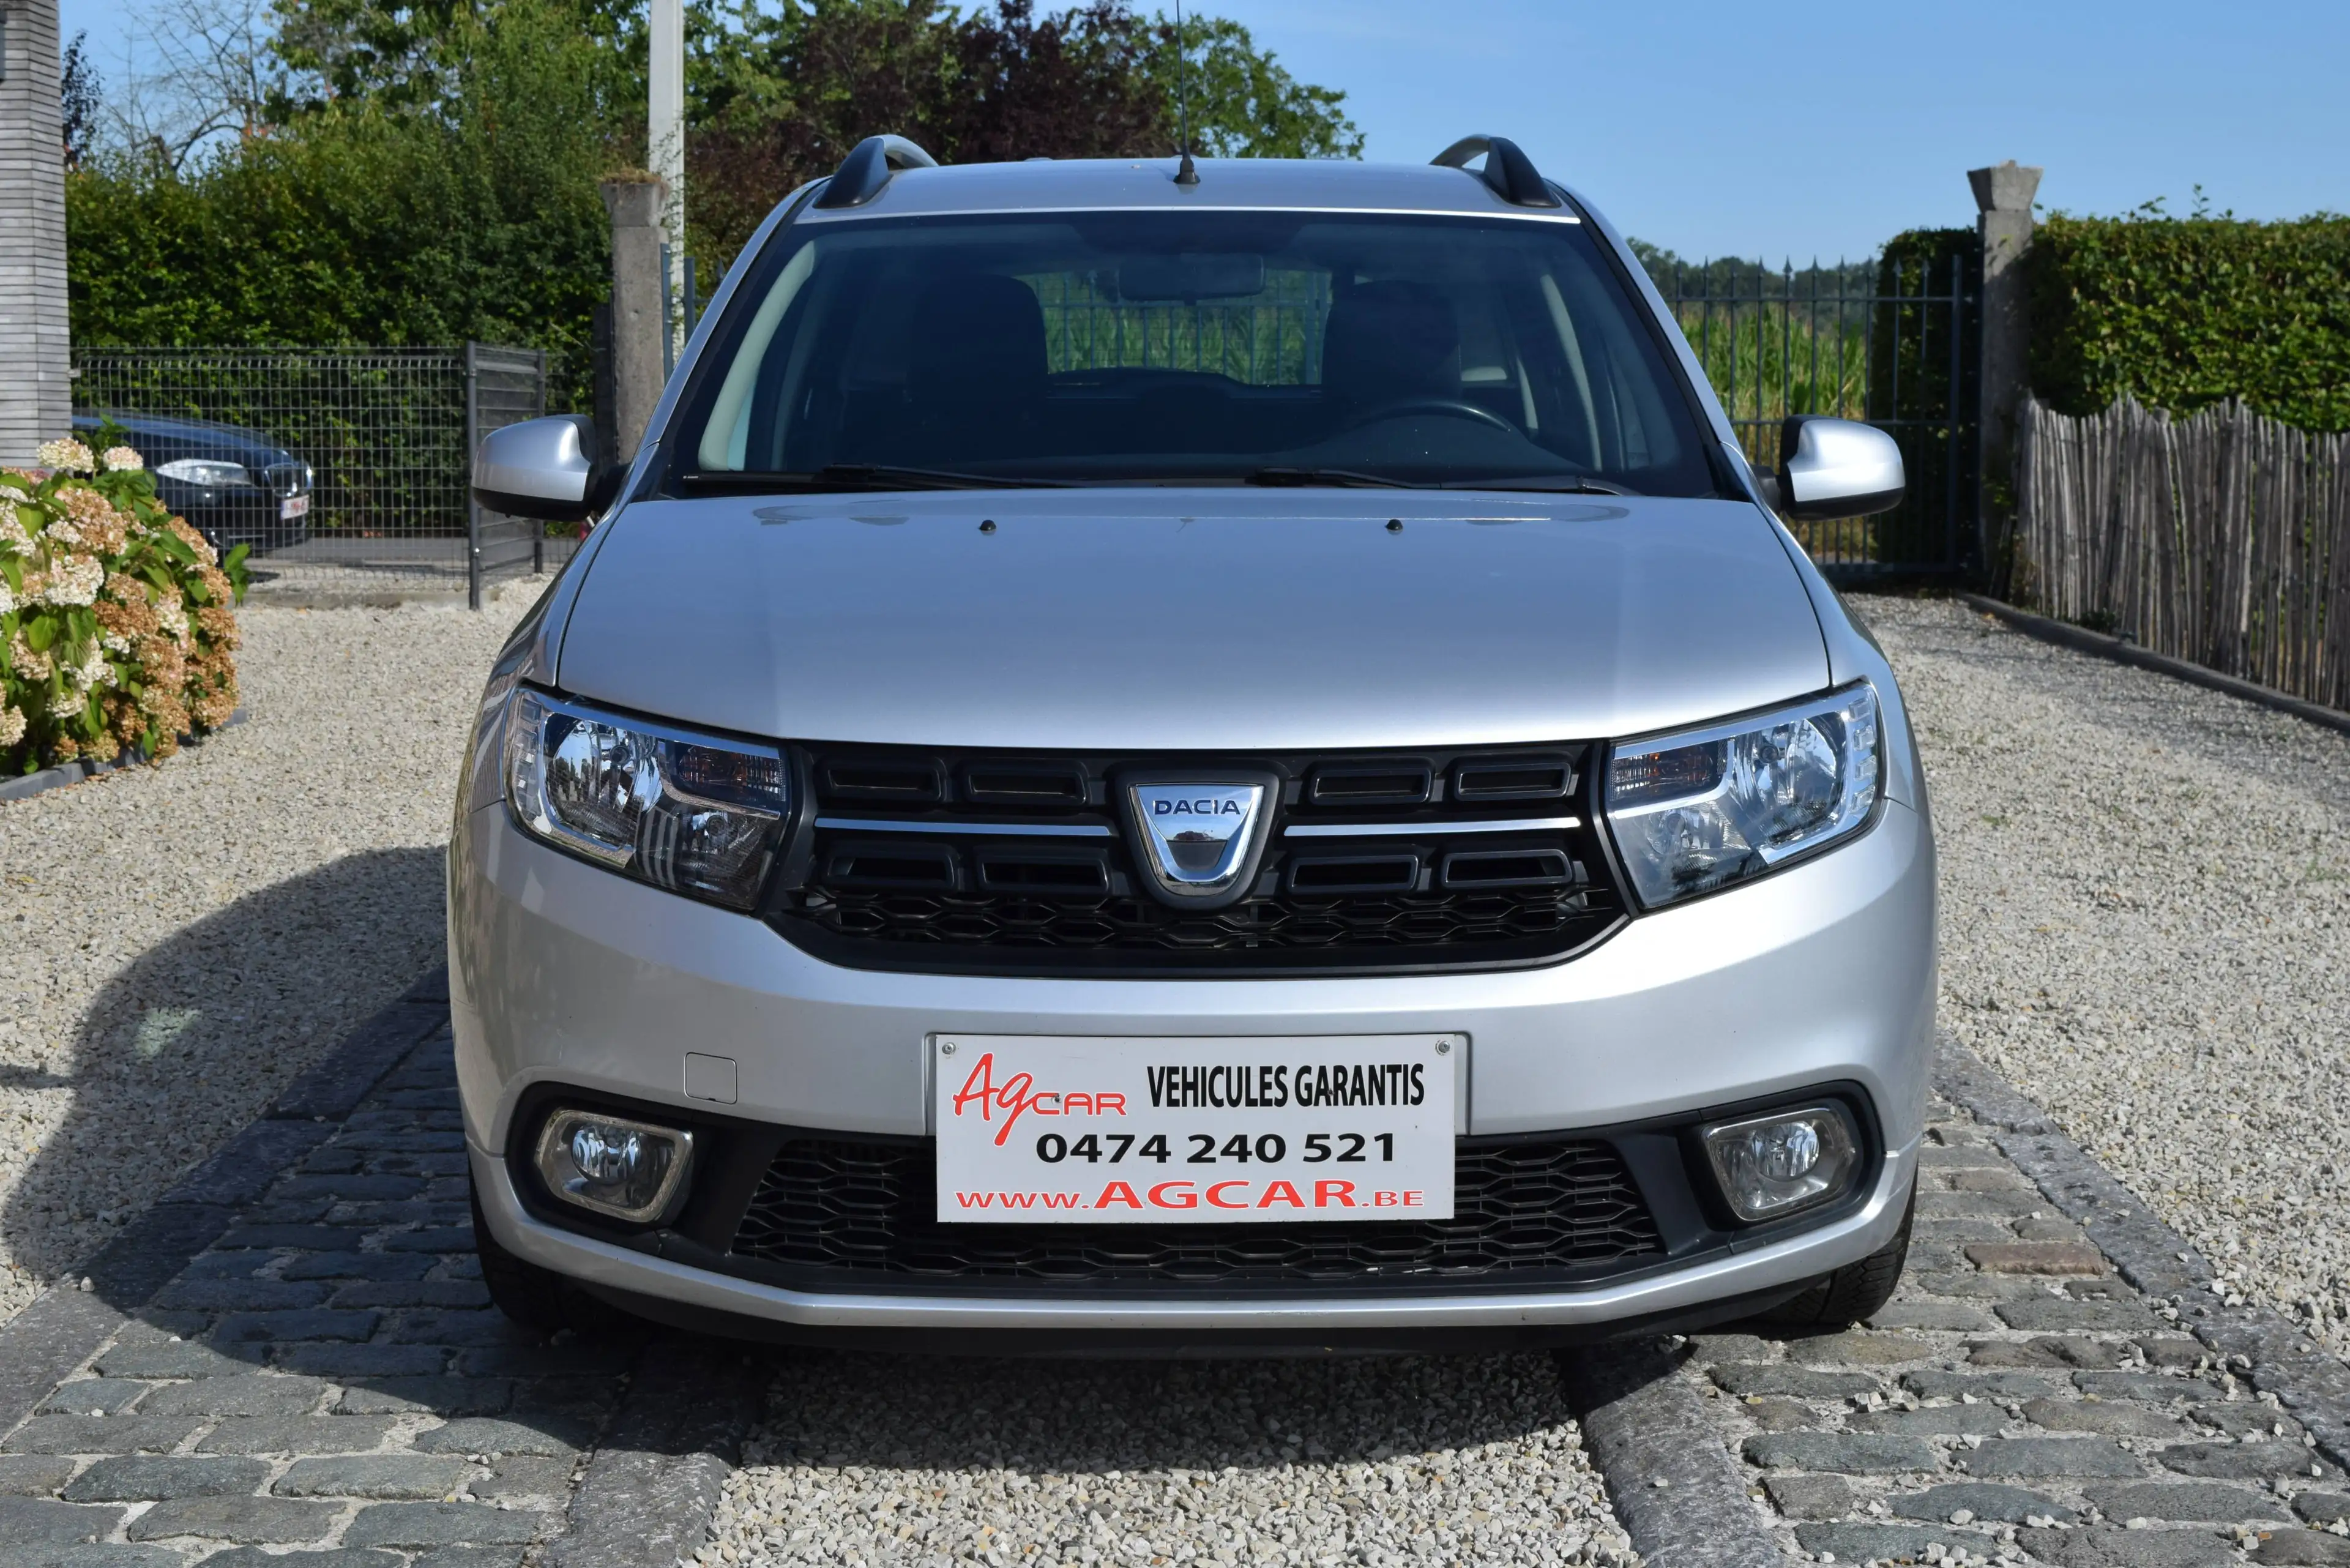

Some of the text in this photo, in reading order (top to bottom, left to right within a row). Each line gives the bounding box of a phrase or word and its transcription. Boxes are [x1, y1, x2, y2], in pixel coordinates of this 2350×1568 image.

[1154, 799, 1240, 815] DACIA
[1147, 1063, 1424, 1107] VEHICULES GARANTIS
[1036, 1133, 1393, 1163] 0474 240 521
[954, 1179, 1424, 1209] www.AGCAR.BE
